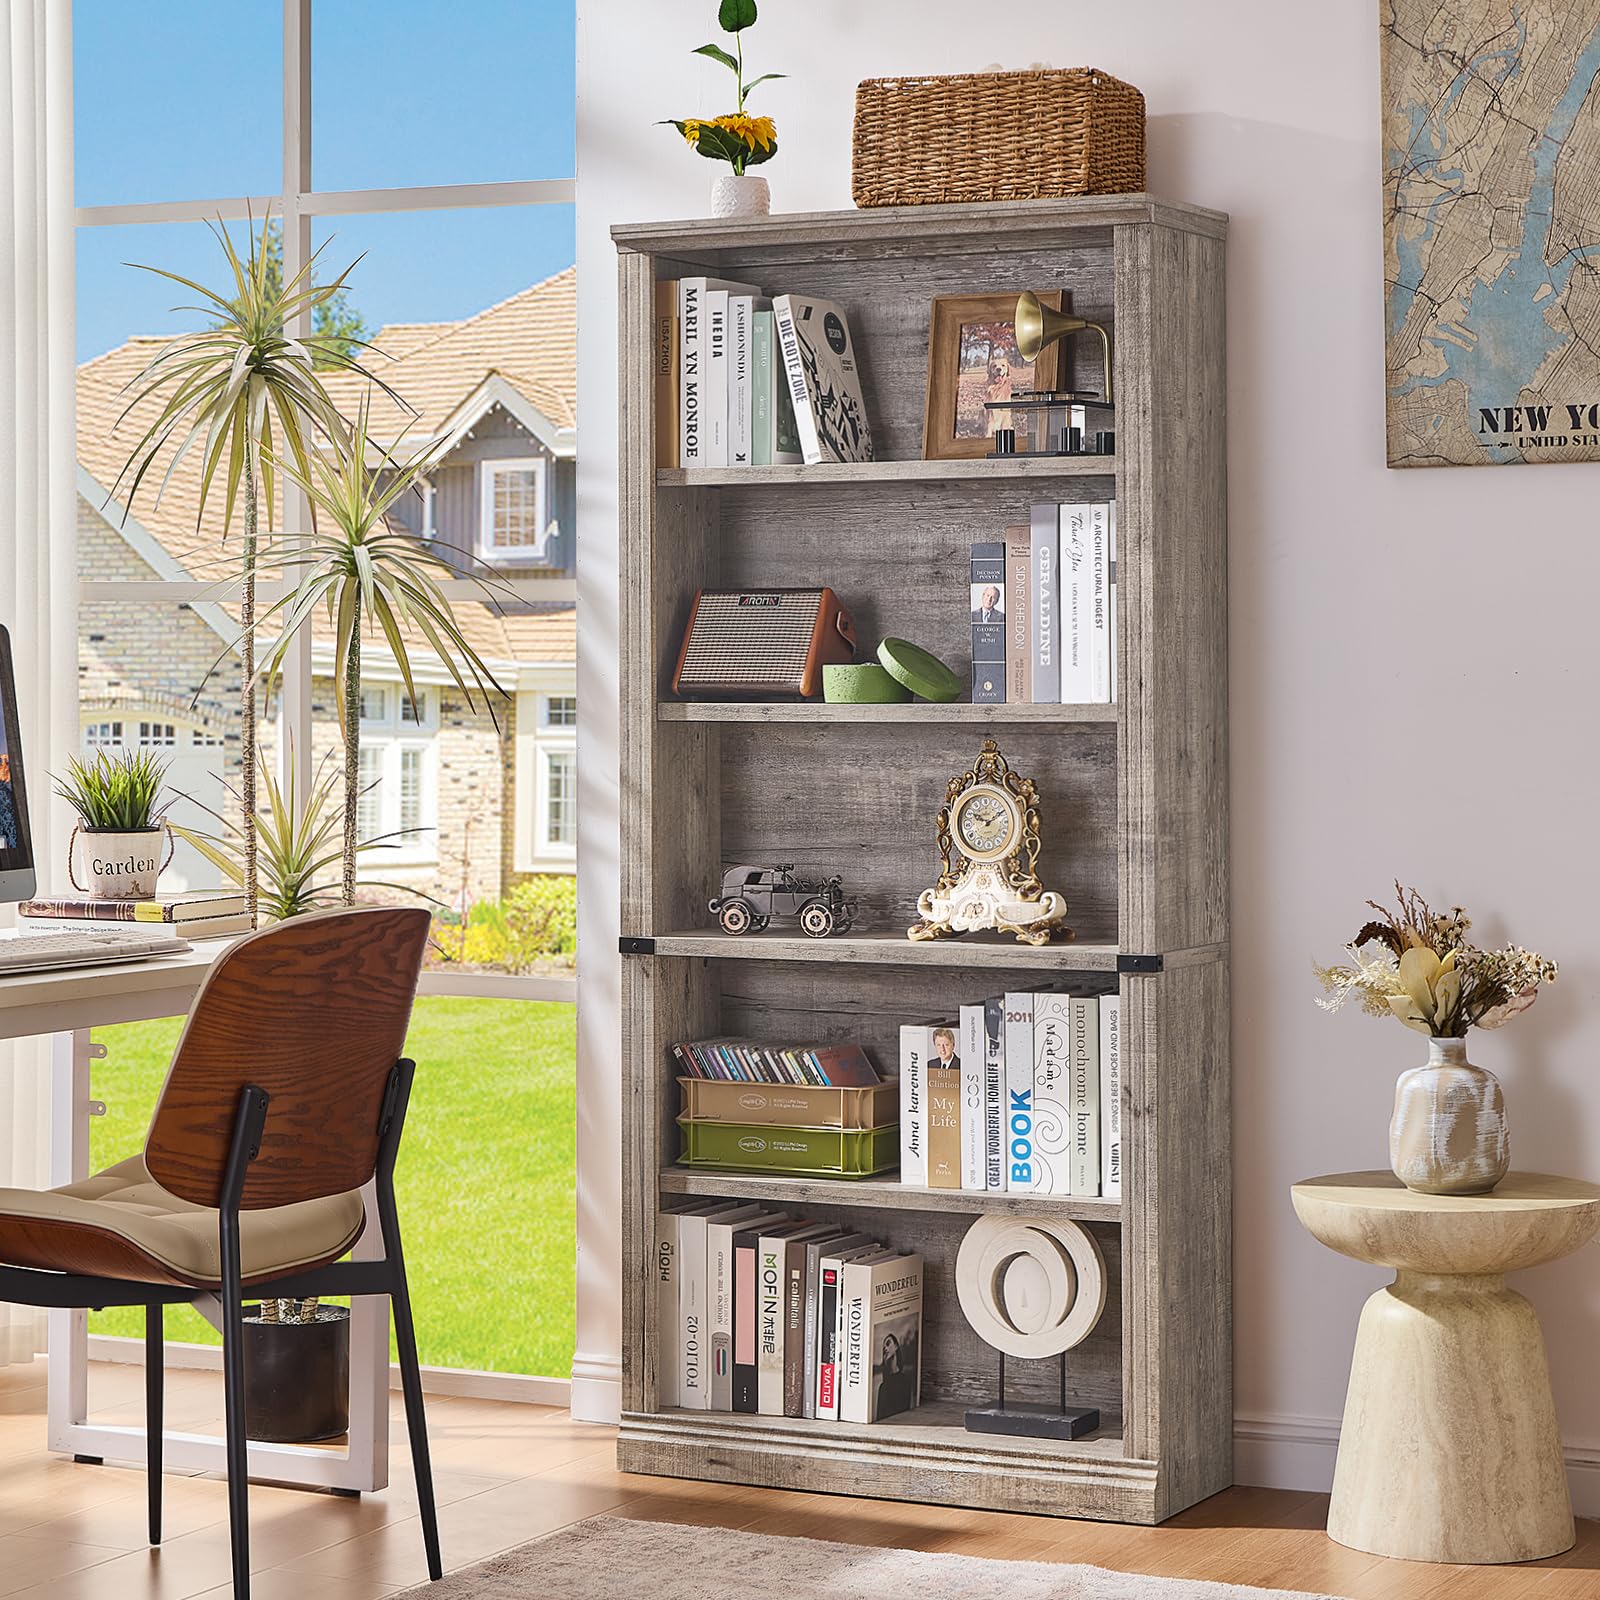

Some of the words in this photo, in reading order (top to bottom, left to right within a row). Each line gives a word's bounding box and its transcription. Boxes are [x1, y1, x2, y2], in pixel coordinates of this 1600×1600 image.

[661, 319, 670, 342] LISA
[686, 288, 698, 344] MARIL
[779, 319, 792, 340] DIE
[661, 344, 670, 373] ZHOU
[736, 304, 746, 381] FASHIONINDIA
[784, 341, 800, 371] ROTE
[686, 351, 698, 375] YN
[790, 373, 808, 404] ZONE
[686, 382, 698, 458] MONROE
[1479, 405, 1553, 434] NEW
[1518, 435, 1568, 448] UNITED
[1572, 434, 1600, 446] STA
[1094, 524, 1103, 597] ARCHITECTURAL
[1015, 566, 1025, 602] SIDNEY
[1015, 602, 1025, 650] SHELDON
[1095, 598, 1103, 630] DIGEST
[93, 855, 155, 876] Garden
[1006, 1011, 1032, 1023] 2011
[1110, 1010, 1118, 1031] BAGS
[1046, 1024, 1056, 1090] Madame
[1075, 1004, 1090, 1107] monochrome
[1110, 1033, 1118, 1052] AND
[907, 1052, 919, 1113] karenina
[987, 1062, 1000, 1103] HOMELIFE
[1110, 1053, 1118, 1078] SHOES
[933, 1098, 955, 1113] My
[966, 1073, 979, 1109] COS
[1110, 1079, 1119, 1097] BEST
[931, 1114, 957, 1128] Life
[987, 1105, 1000, 1156] WONDERFUL
[1010, 1089, 1032, 1183] BOOK
[1077, 1112, 1091, 1156] home
[908, 1121, 919, 1158] Anna
[987, 1158, 1000, 1187] CREATE
[1110, 1143, 1120, 1183] FASHION
[658, 1241, 670, 1281] PHOTO
[875, 1274, 919, 1297] WONDERFUL
[686, 1316, 699, 1388] FOLIO-02
[849, 1297, 862, 1388] WONDERFUL
[823, 1367, 832, 1404] OLIVIA
